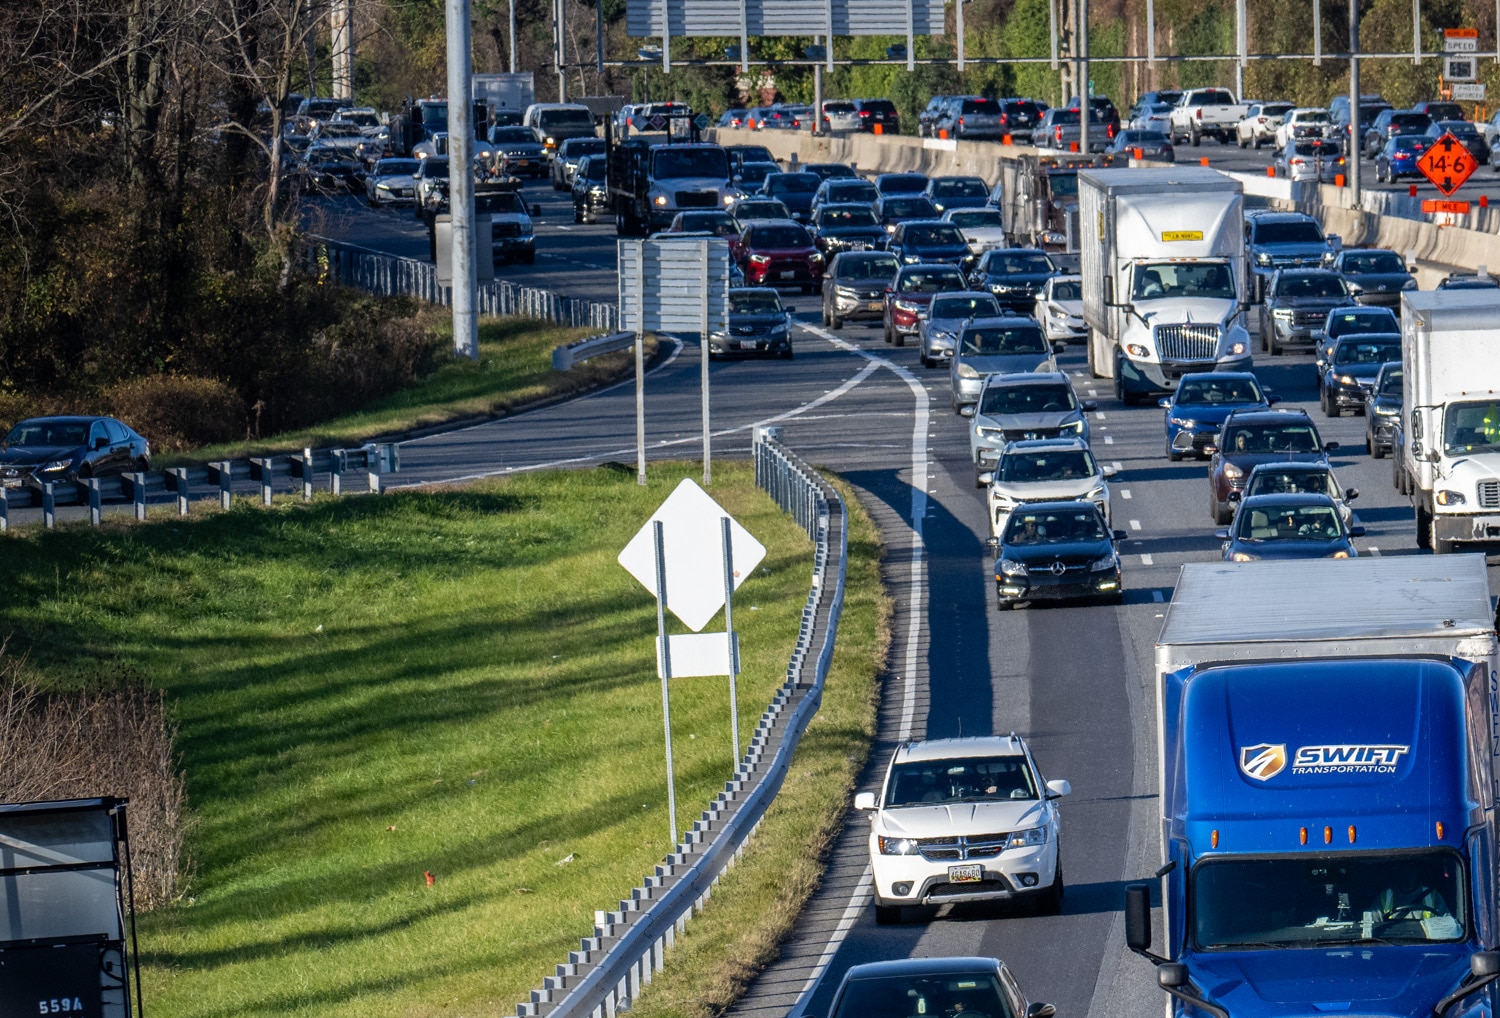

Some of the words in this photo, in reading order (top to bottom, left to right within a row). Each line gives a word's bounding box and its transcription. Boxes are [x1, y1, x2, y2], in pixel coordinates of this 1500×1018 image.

[1447, 42, 1474, 50] SPEED
[1442, 203, 1458, 211] MILE
[1296, 746, 1408, 765] SWIFT
[1291, 765, 1397, 775] TRANSPORTATION
[39, 997, 82, 1014] 559A
